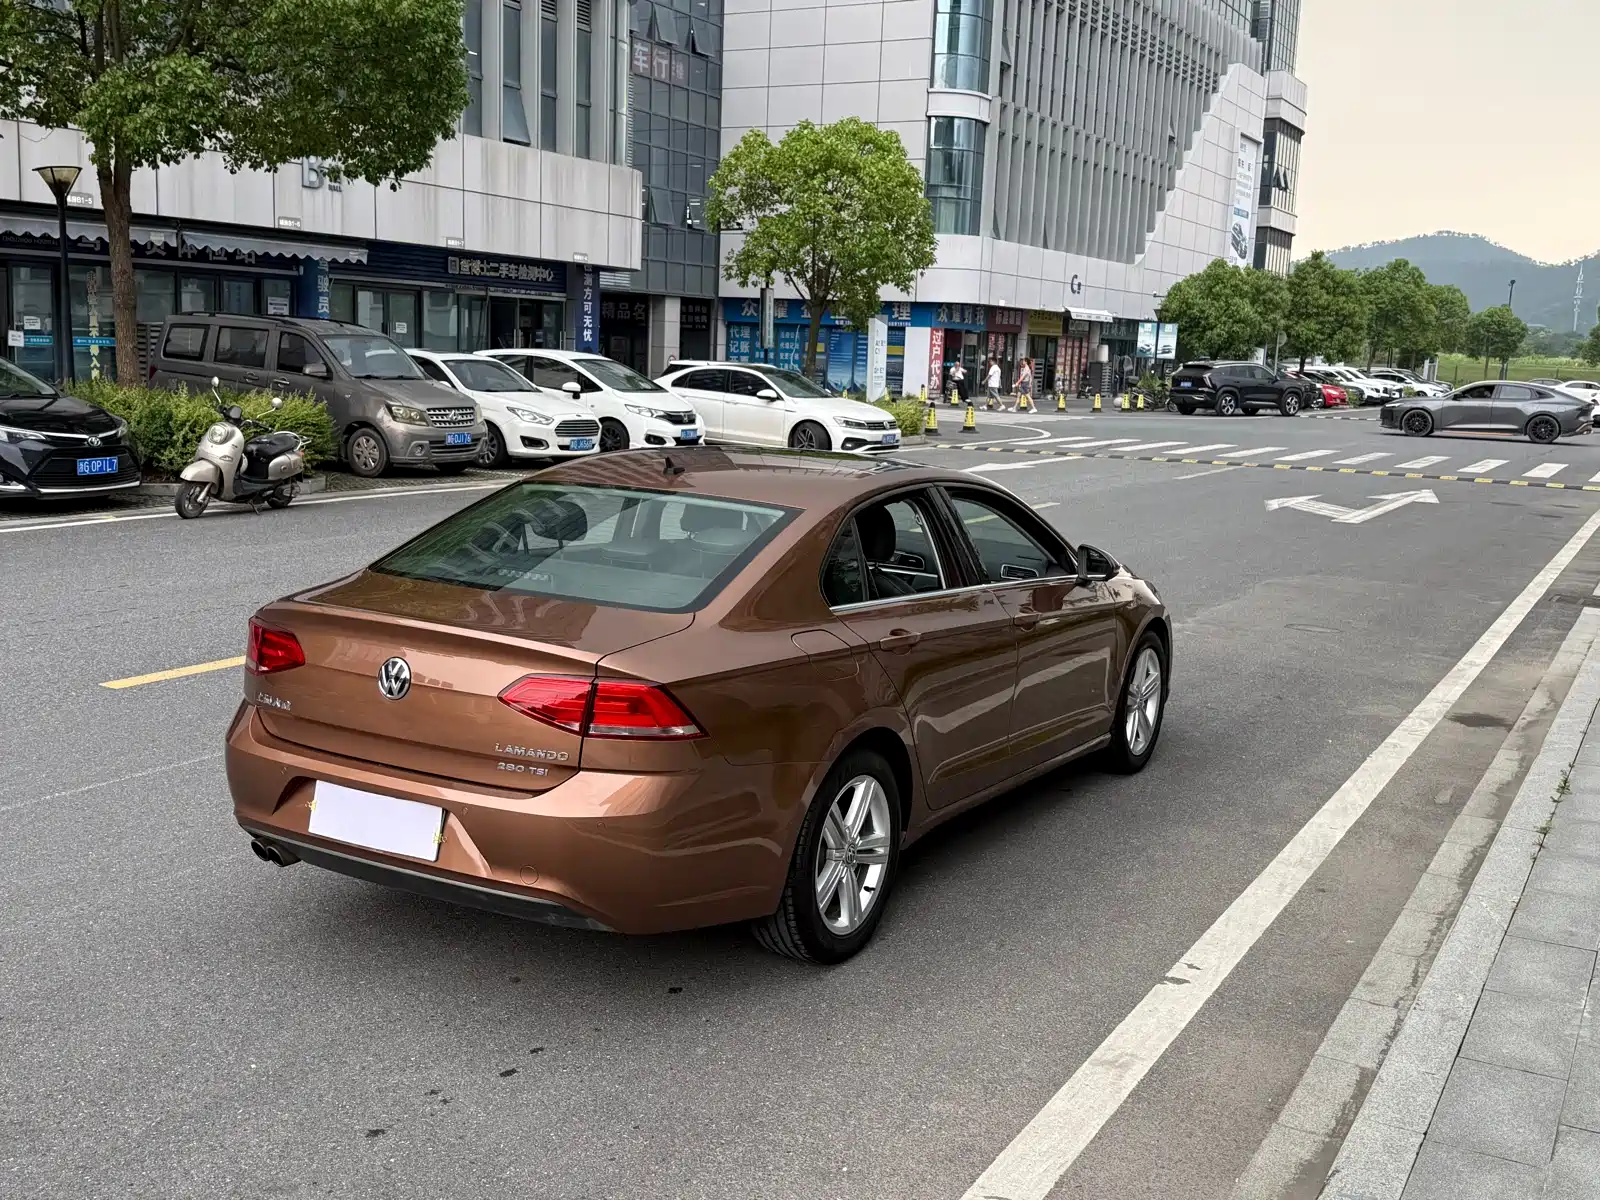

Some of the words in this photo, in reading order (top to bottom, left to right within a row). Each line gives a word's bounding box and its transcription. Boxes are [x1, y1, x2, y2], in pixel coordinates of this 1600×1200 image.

[930, 331, 944, 389] 过户代办
[495, 743, 569, 760] LAMANDO
[497, 762, 525, 772] 280
[529, 766, 549, 776] TSI
